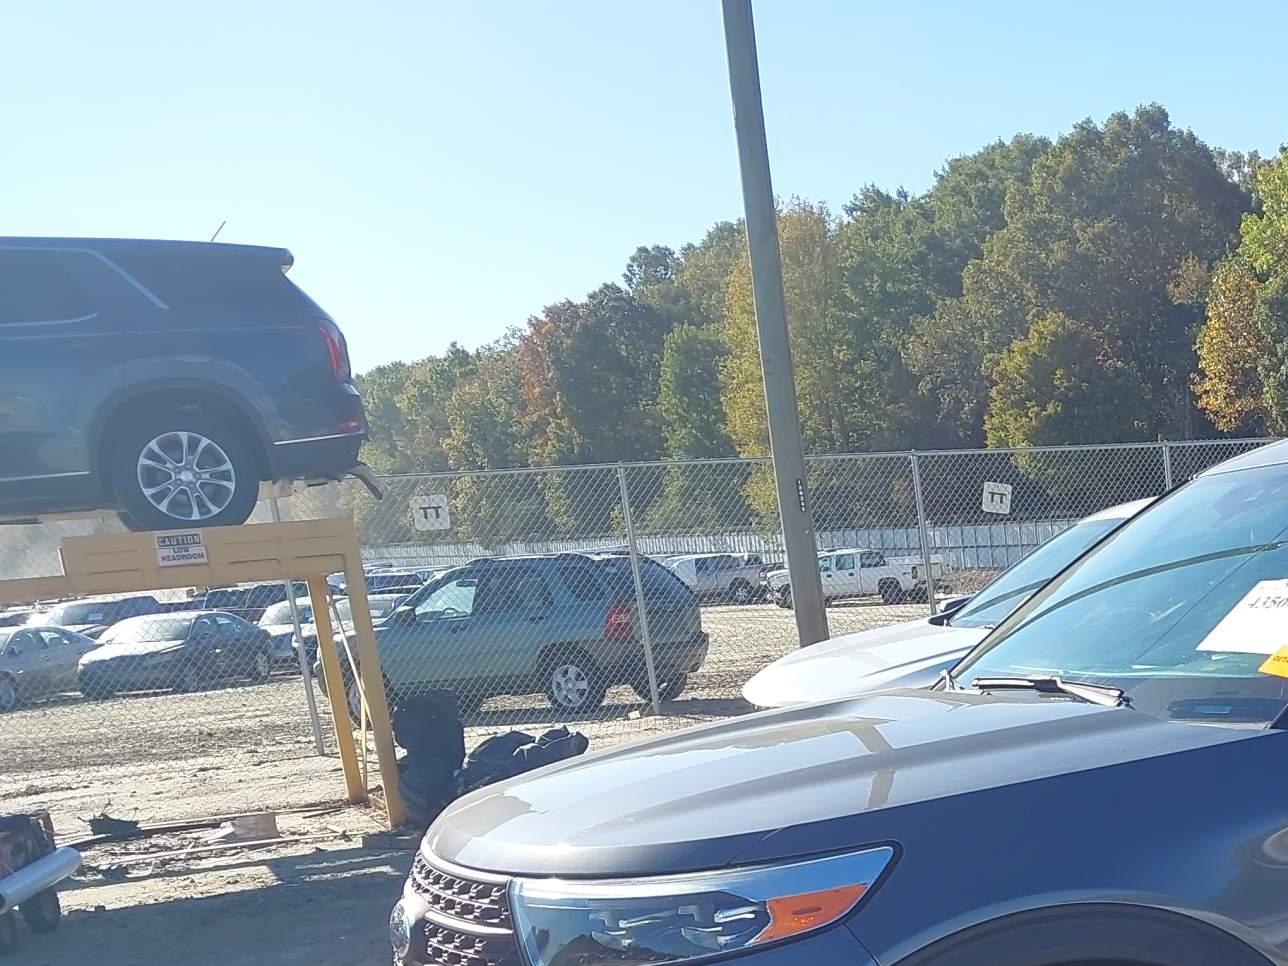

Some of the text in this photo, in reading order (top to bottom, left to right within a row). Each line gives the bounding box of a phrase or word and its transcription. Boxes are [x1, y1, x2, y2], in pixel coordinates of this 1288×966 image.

[988, 491, 1007, 505] TT
[418, 505, 443, 520] TT
[158, 534, 201, 547] CAUTION
[161, 552, 205, 563] HEADROOM
